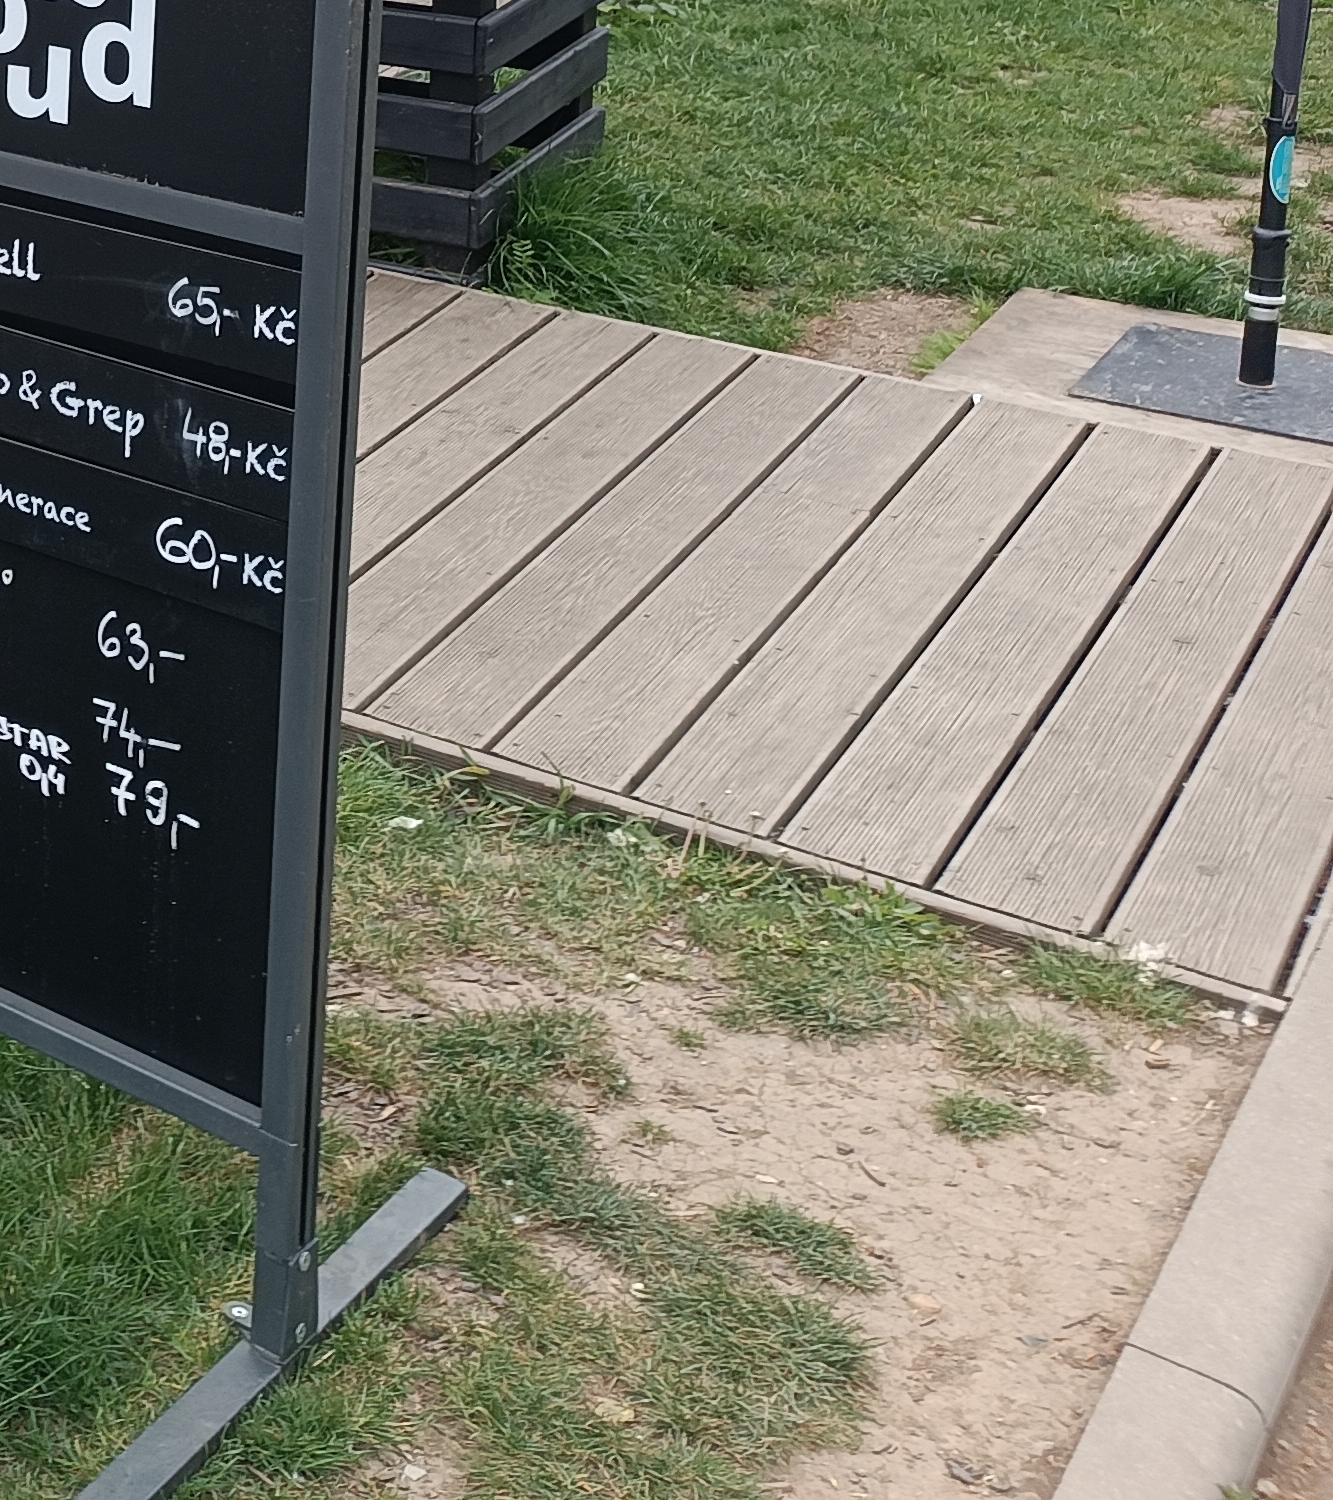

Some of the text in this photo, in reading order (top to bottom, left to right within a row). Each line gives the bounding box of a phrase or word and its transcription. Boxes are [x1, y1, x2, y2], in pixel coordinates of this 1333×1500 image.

[17, 369, 43, 410] &
[49, 381, 145, 457] Grep
[96, 610, 187, 684] 63,-
